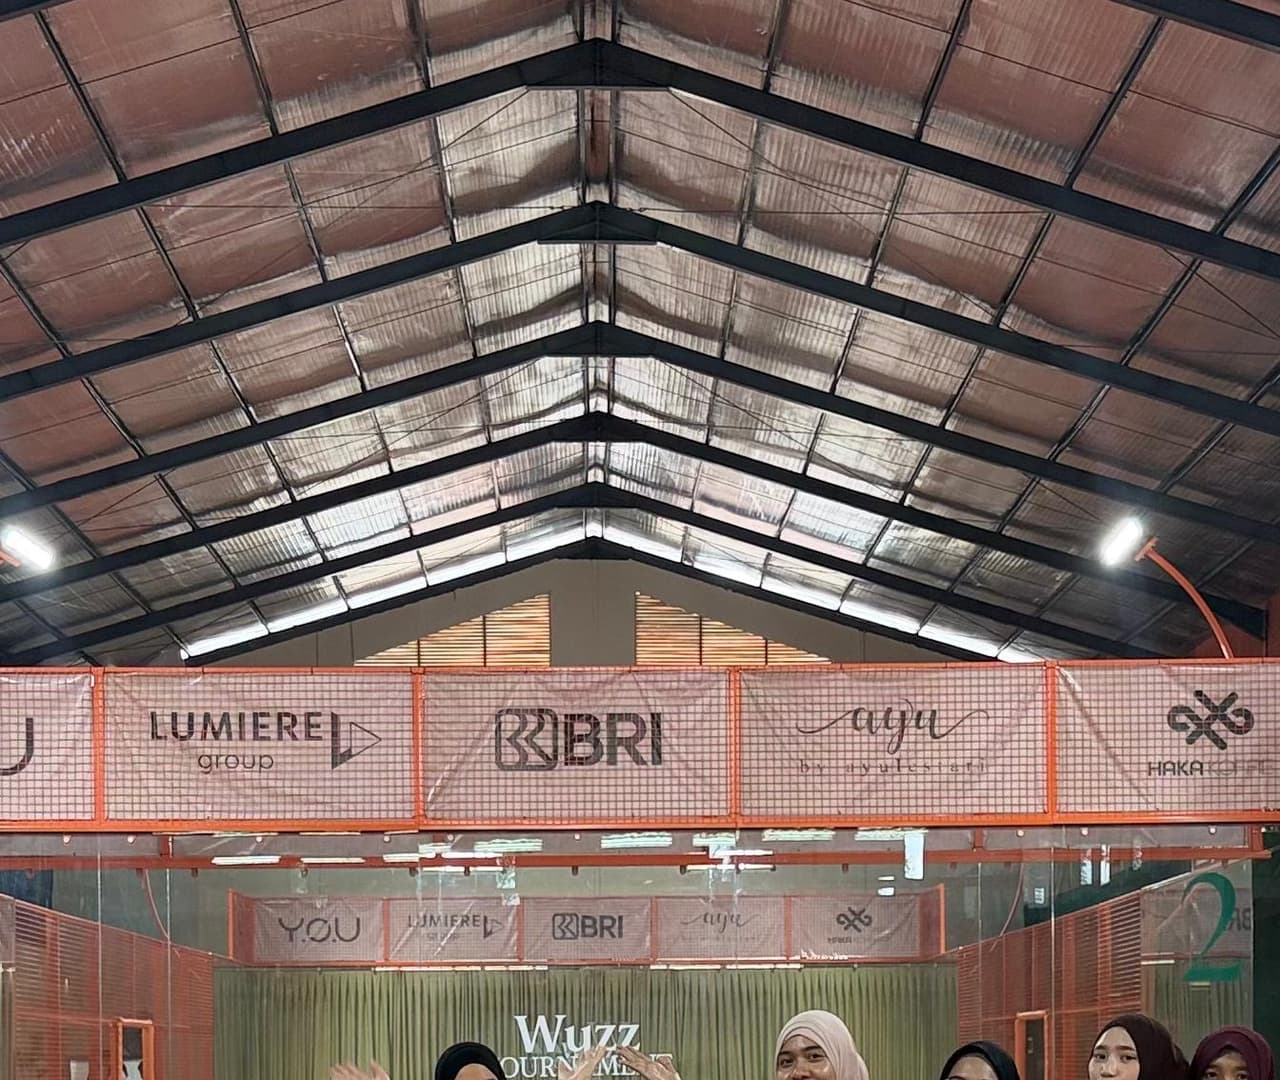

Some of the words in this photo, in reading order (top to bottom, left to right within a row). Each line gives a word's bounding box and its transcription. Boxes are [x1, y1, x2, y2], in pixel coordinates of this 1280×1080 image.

[150, 711, 323, 742] LUMIERE
[564, 712, 662, 766] BRI
[796, 698, 989, 754] ayu
[198, 753, 274, 774] group
[1148, 760, 1204, 777] HAKA
[408, 914, 481, 928] LUMIERE
[581, 915, 624, 939] BRI
[1183, 872, 1241, 982] 2
[513, 1014, 641, 1054] Wuzz
